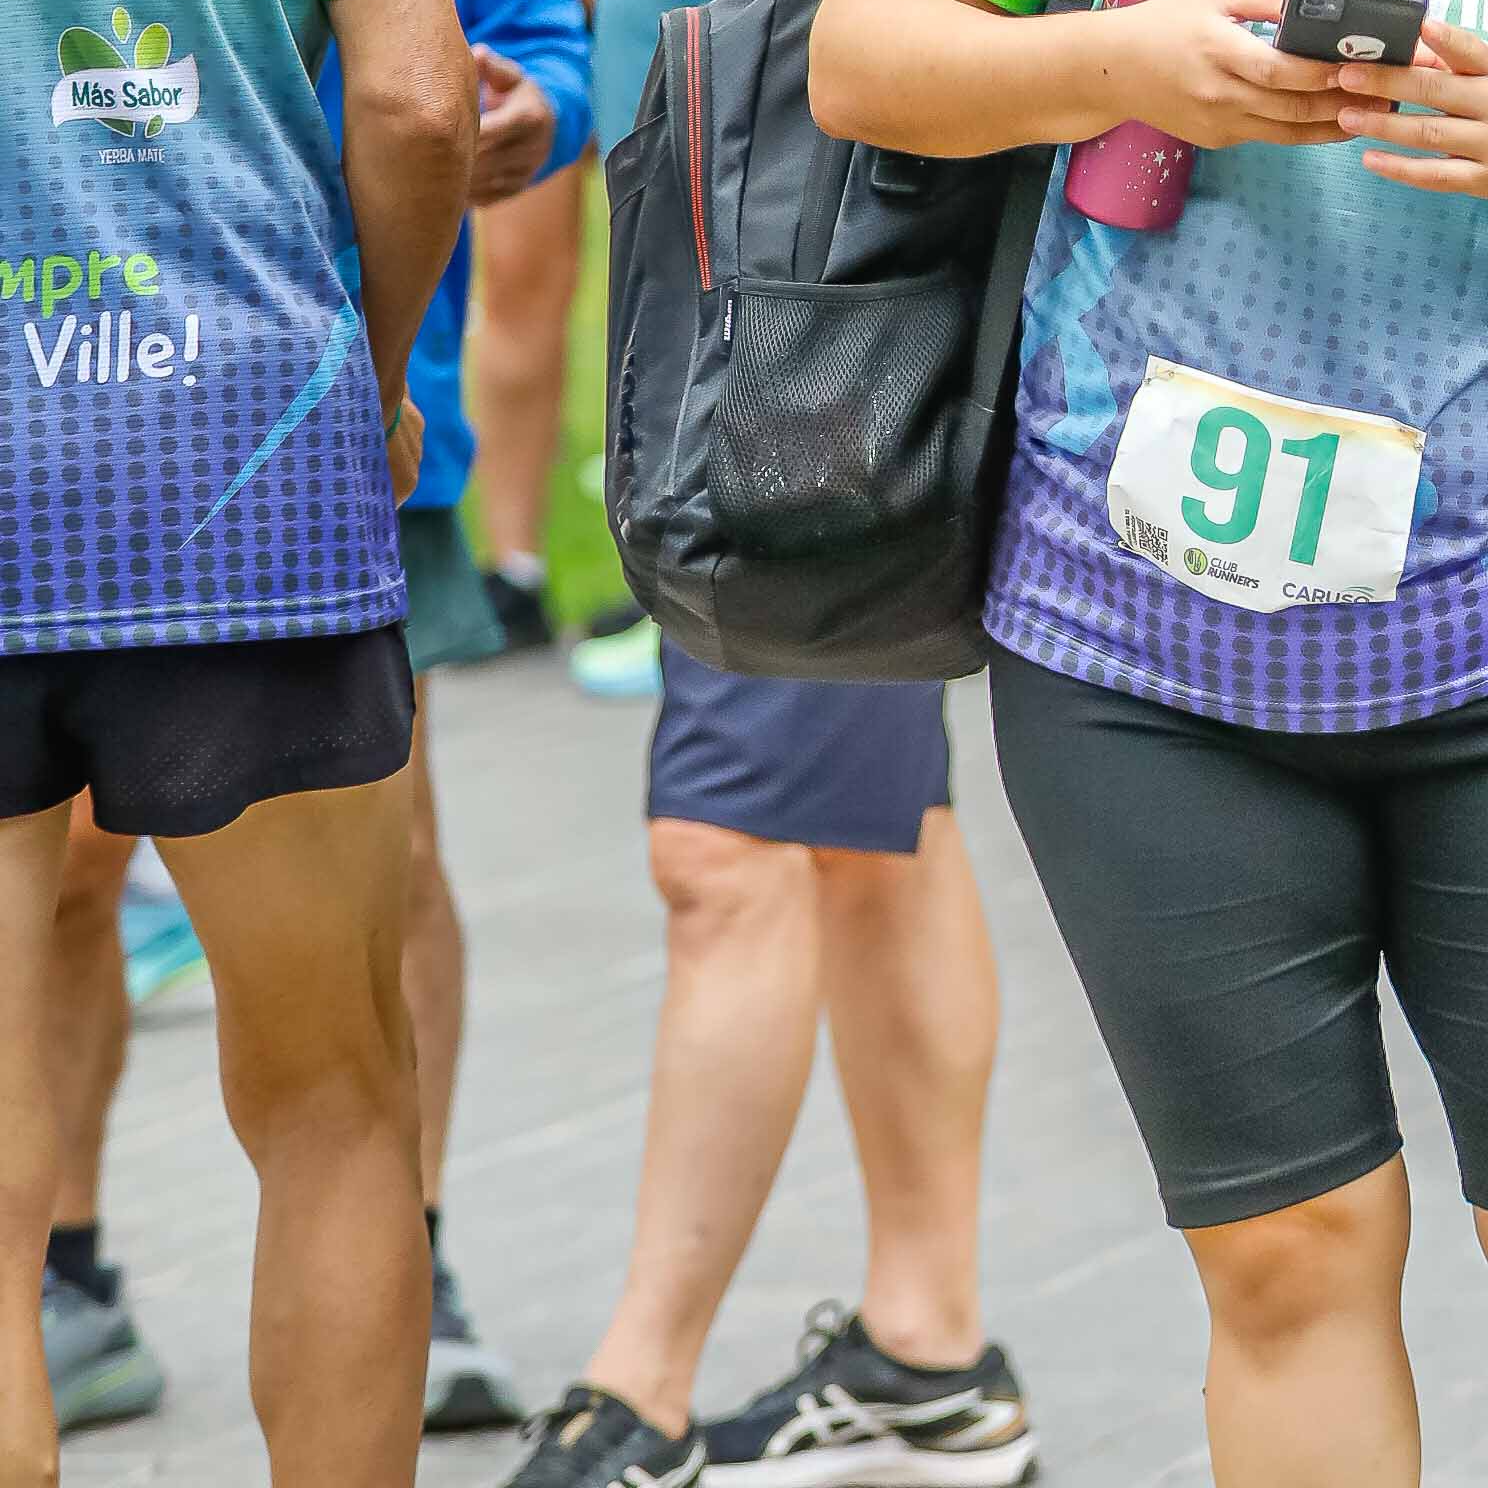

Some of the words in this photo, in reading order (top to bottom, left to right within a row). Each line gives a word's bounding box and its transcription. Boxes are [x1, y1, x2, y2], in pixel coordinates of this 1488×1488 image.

[71, 79, 116, 108] Más
[122, 78, 182, 108] Sabor
[98, 148, 135, 164] YERBA
[23, 310, 200, 388] Ville!
[1181, 406, 1340, 566] 91
[1210, 557, 1239, 573] CLUB
